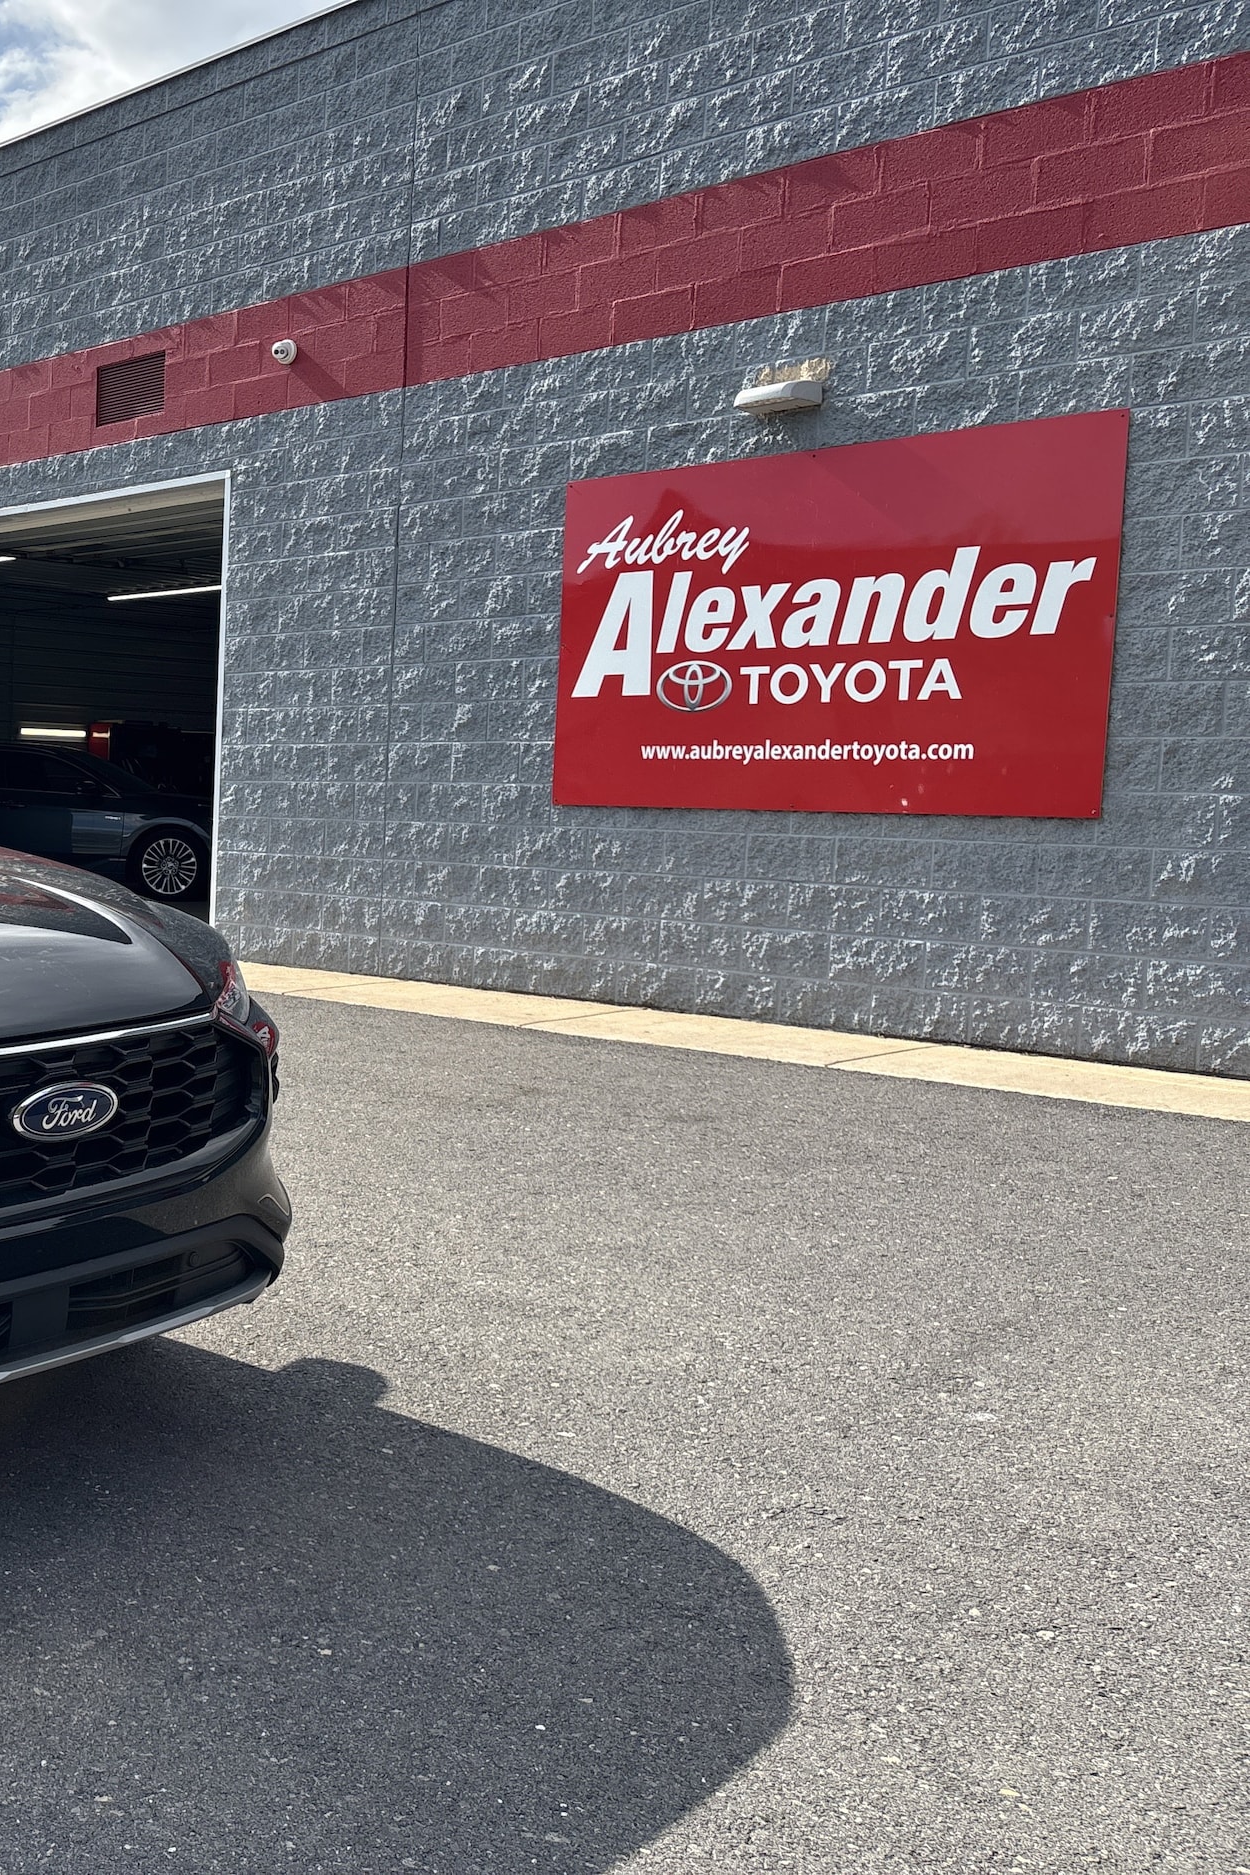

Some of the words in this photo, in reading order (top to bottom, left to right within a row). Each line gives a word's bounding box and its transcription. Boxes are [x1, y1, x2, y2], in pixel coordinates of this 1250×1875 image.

[577, 509, 750, 574] Aubrey
[572, 546, 1097, 698] Alexander
[740, 658, 962, 704] TOYOTA
[640, 738, 975, 765] www.aubreyalexandertoyota.com
[43, 1095, 98, 1130] Ford
